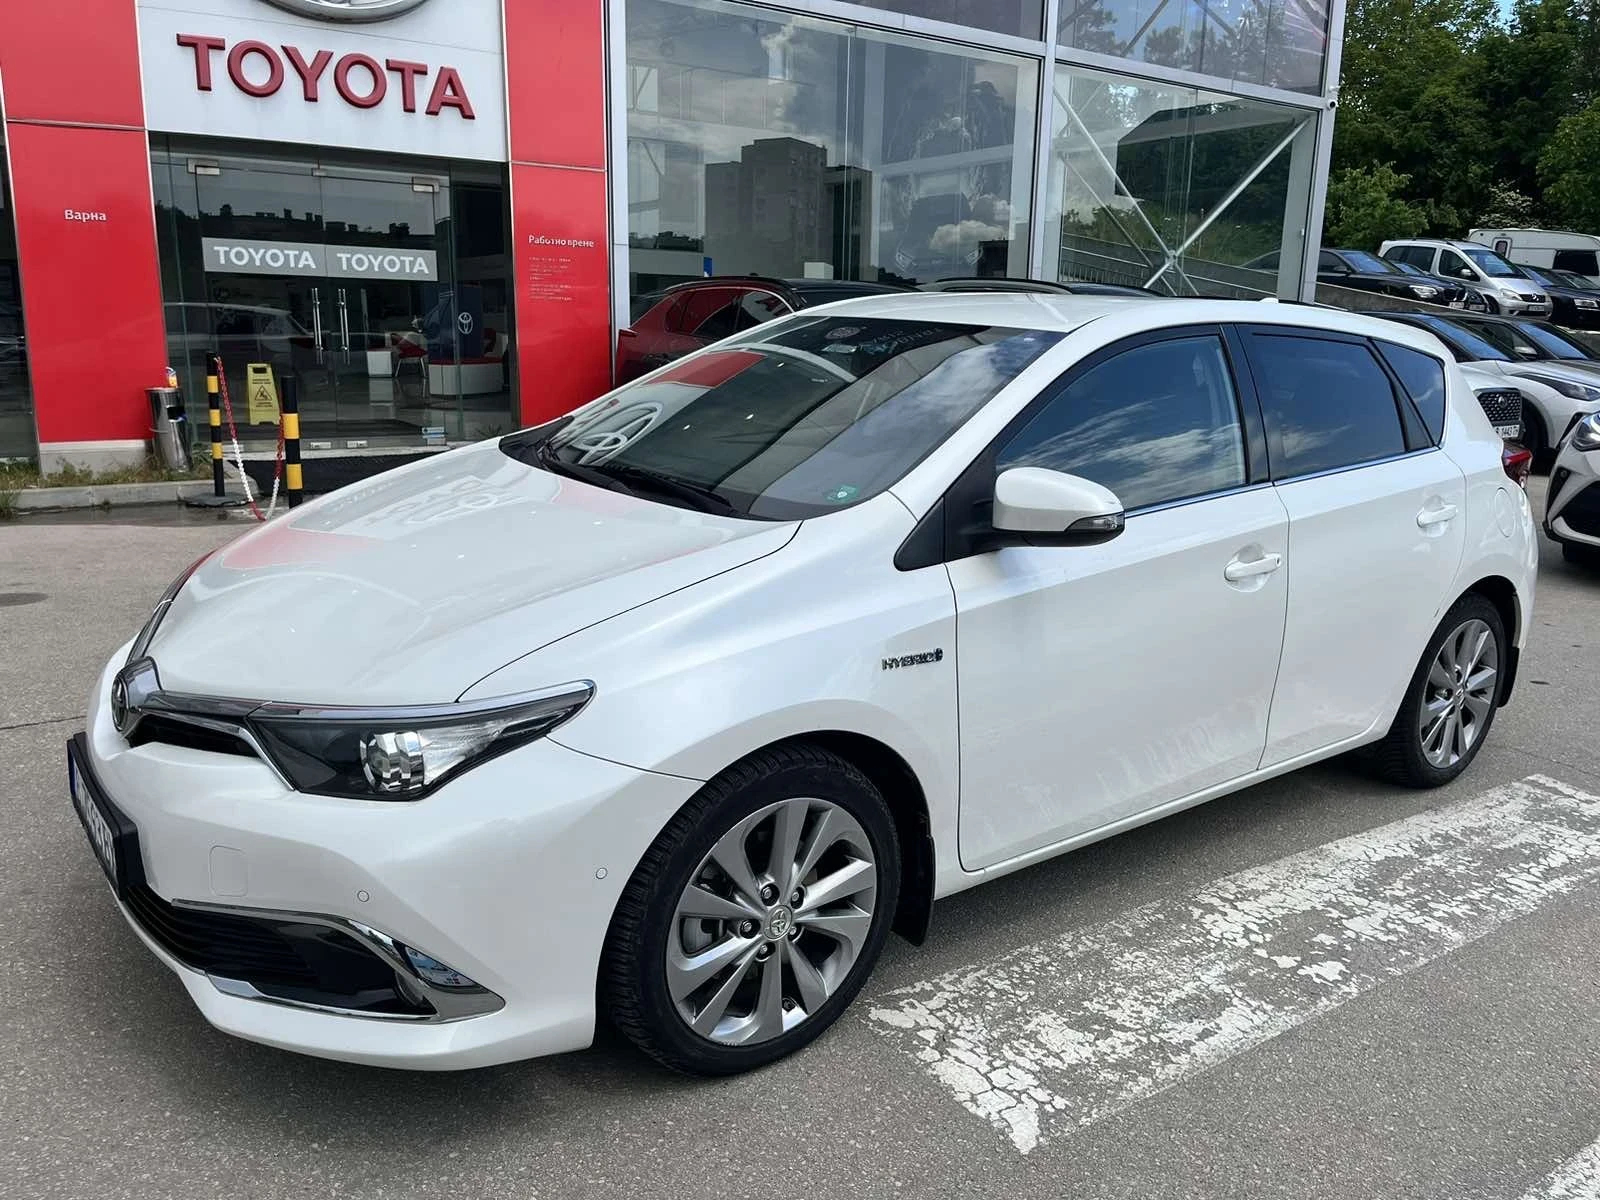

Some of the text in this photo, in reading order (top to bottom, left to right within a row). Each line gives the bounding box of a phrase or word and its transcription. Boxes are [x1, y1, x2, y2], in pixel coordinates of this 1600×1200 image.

[176, 33, 475, 119] TOYOTA
[64, 209, 107, 223] Варна
[528, 235, 566, 246] Работно
[213, 246, 317, 269] TOYOTA
[336, 252, 430, 274] TOYOTA
[881, 652, 935, 670] HYBRID
